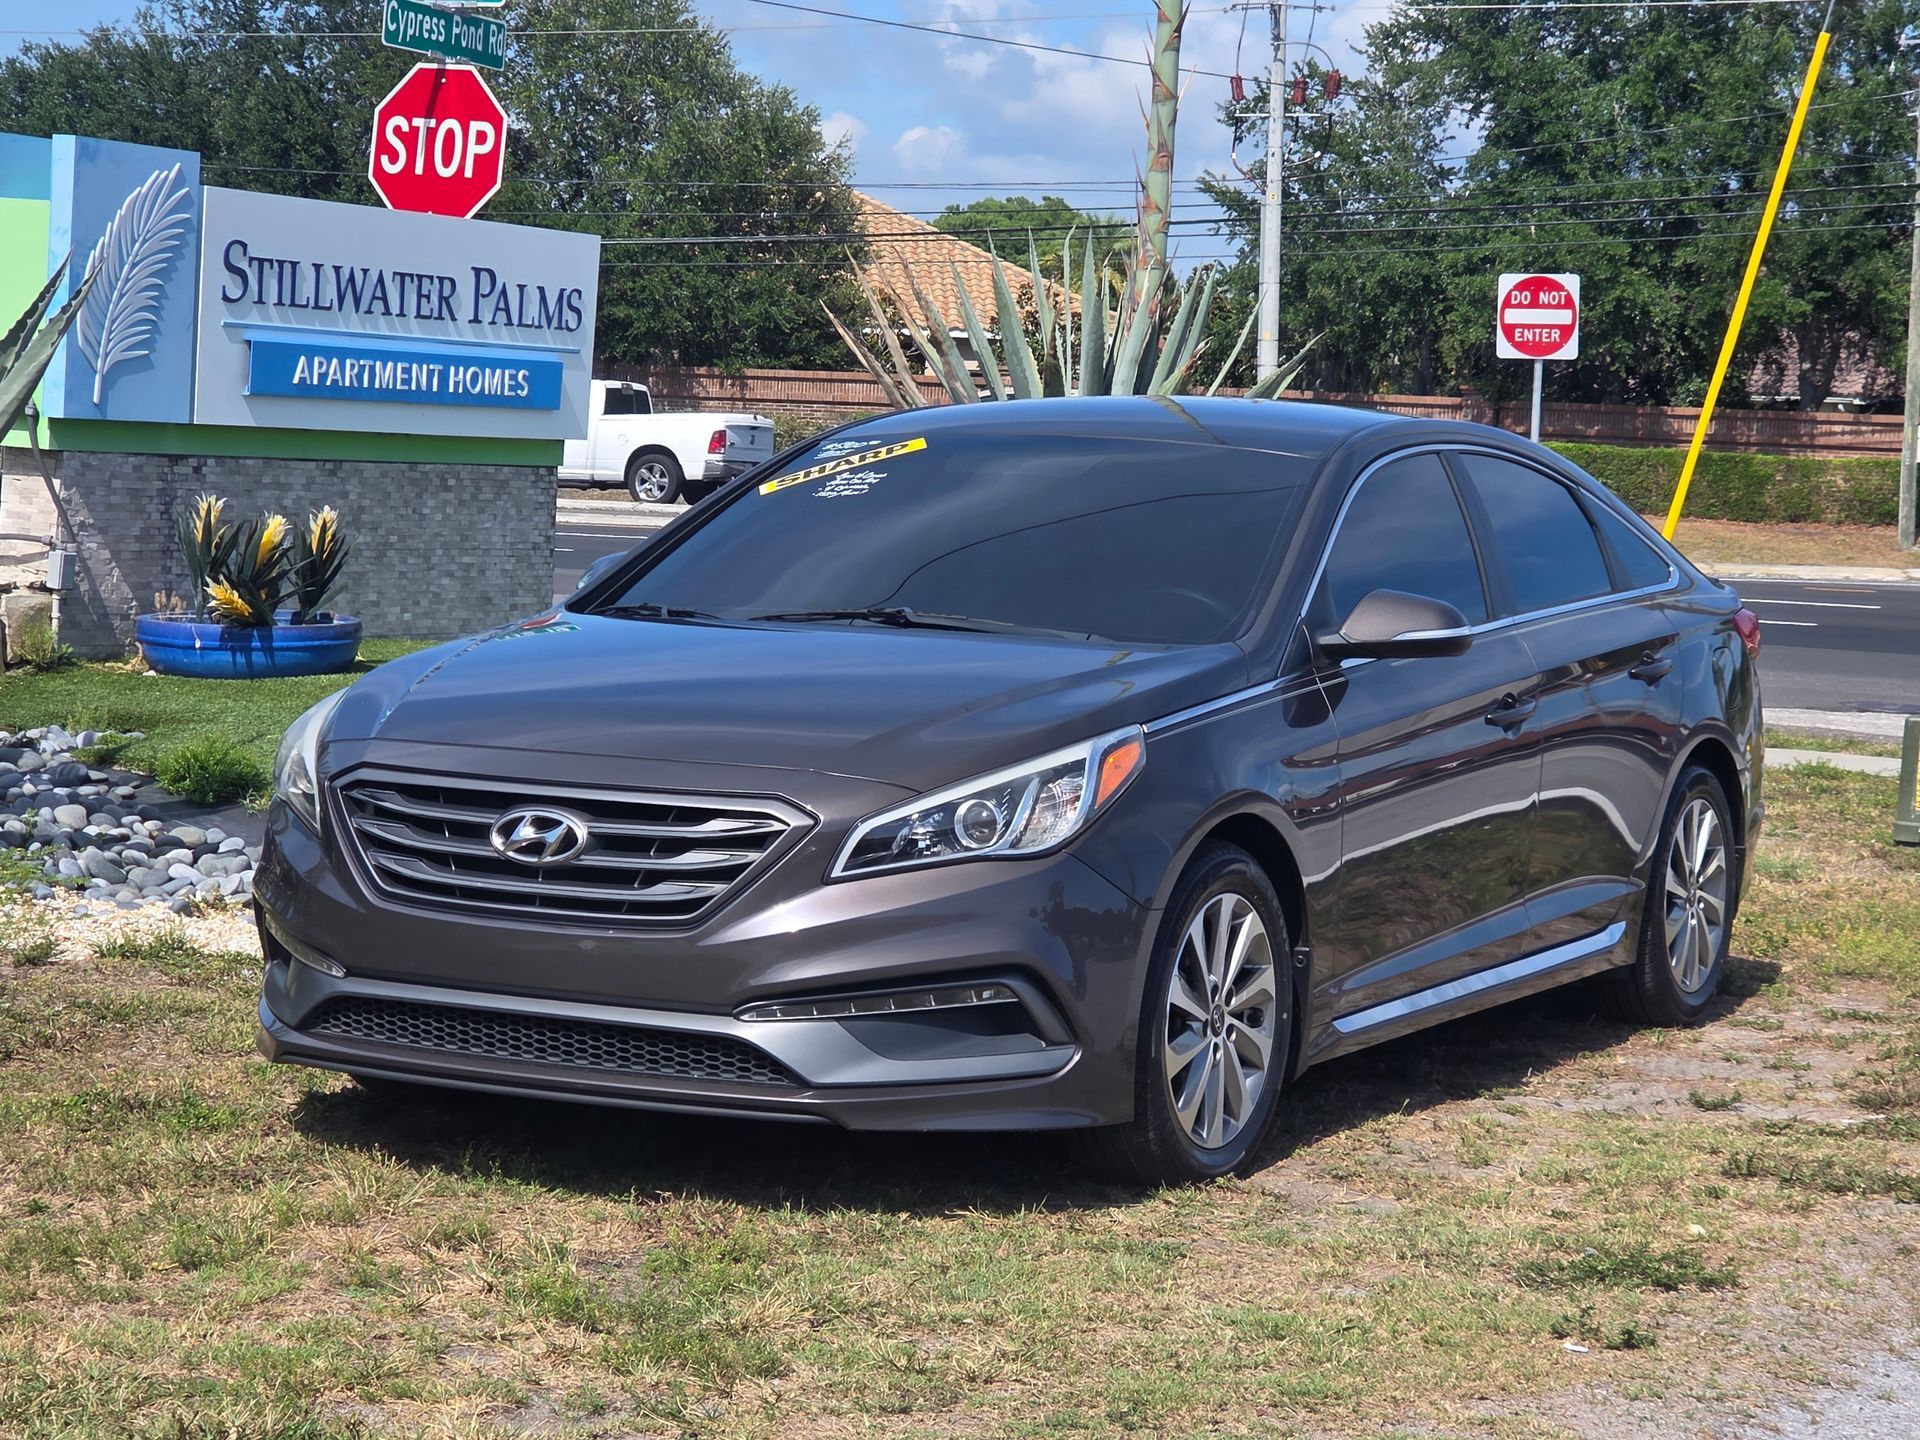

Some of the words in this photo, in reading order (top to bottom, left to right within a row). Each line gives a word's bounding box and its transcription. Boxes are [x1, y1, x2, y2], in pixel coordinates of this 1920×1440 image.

[387, 0, 446, 43] Cypress
[451, 15, 484, 52] Pond
[488, 23, 505, 57] Rd
[380, 116, 496, 180] STOP
[220, 239, 458, 323] STILLWATER
[468, 266, 584, 333] PALMS
[1510, 291, 1531, 305] DO
[1539, 291, 1568, 305] NOT
[1514, 328, 1561, 343] ENTER
[292, 354, 443, 393] APARTMENT
[448, 363, 530, 397] HOMES
[773, 442, 910, 489] SHARP
